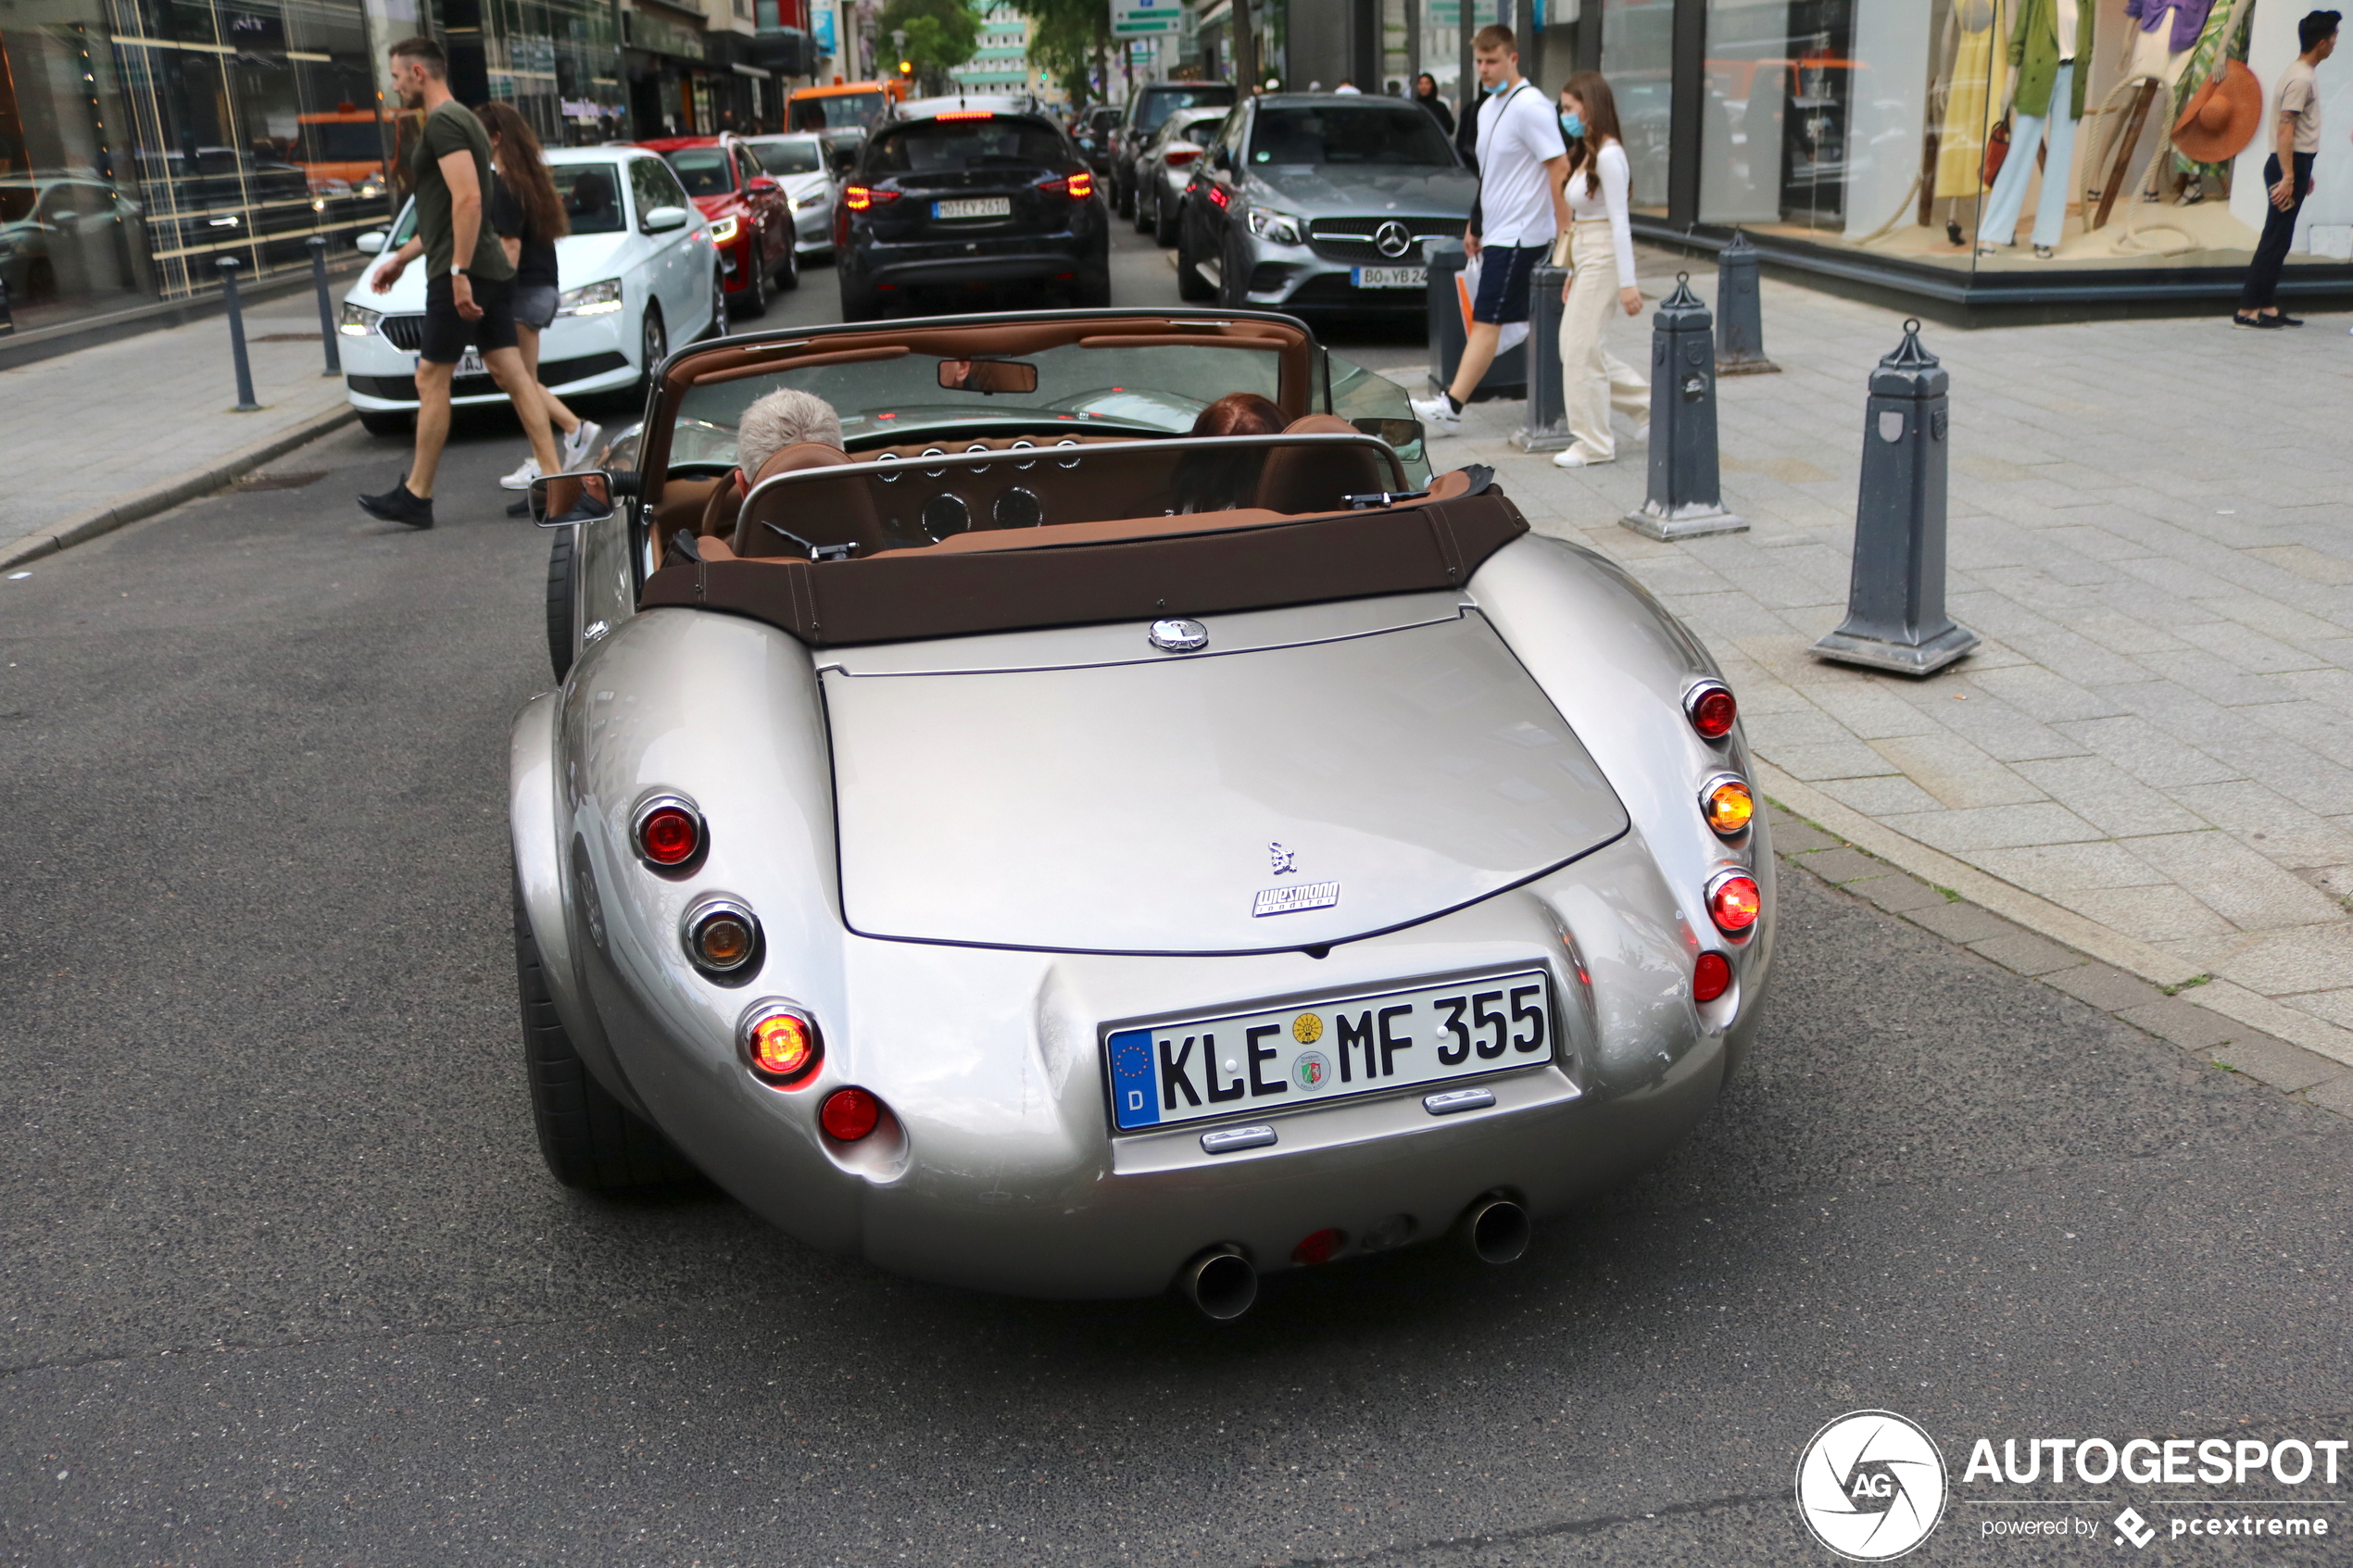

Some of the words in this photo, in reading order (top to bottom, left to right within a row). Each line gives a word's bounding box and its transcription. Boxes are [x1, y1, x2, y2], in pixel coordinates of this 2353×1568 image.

[1365, 270, 1383, 283] BO
[1391, 270, 1409, 282] YB
[1127, 1090, 1144, 1110] D
[1159, 1023, 1288, 1110] KLE
[1336, 1003, 1413, 1083] MF
[1433, 985, 1545, 1066] 355
